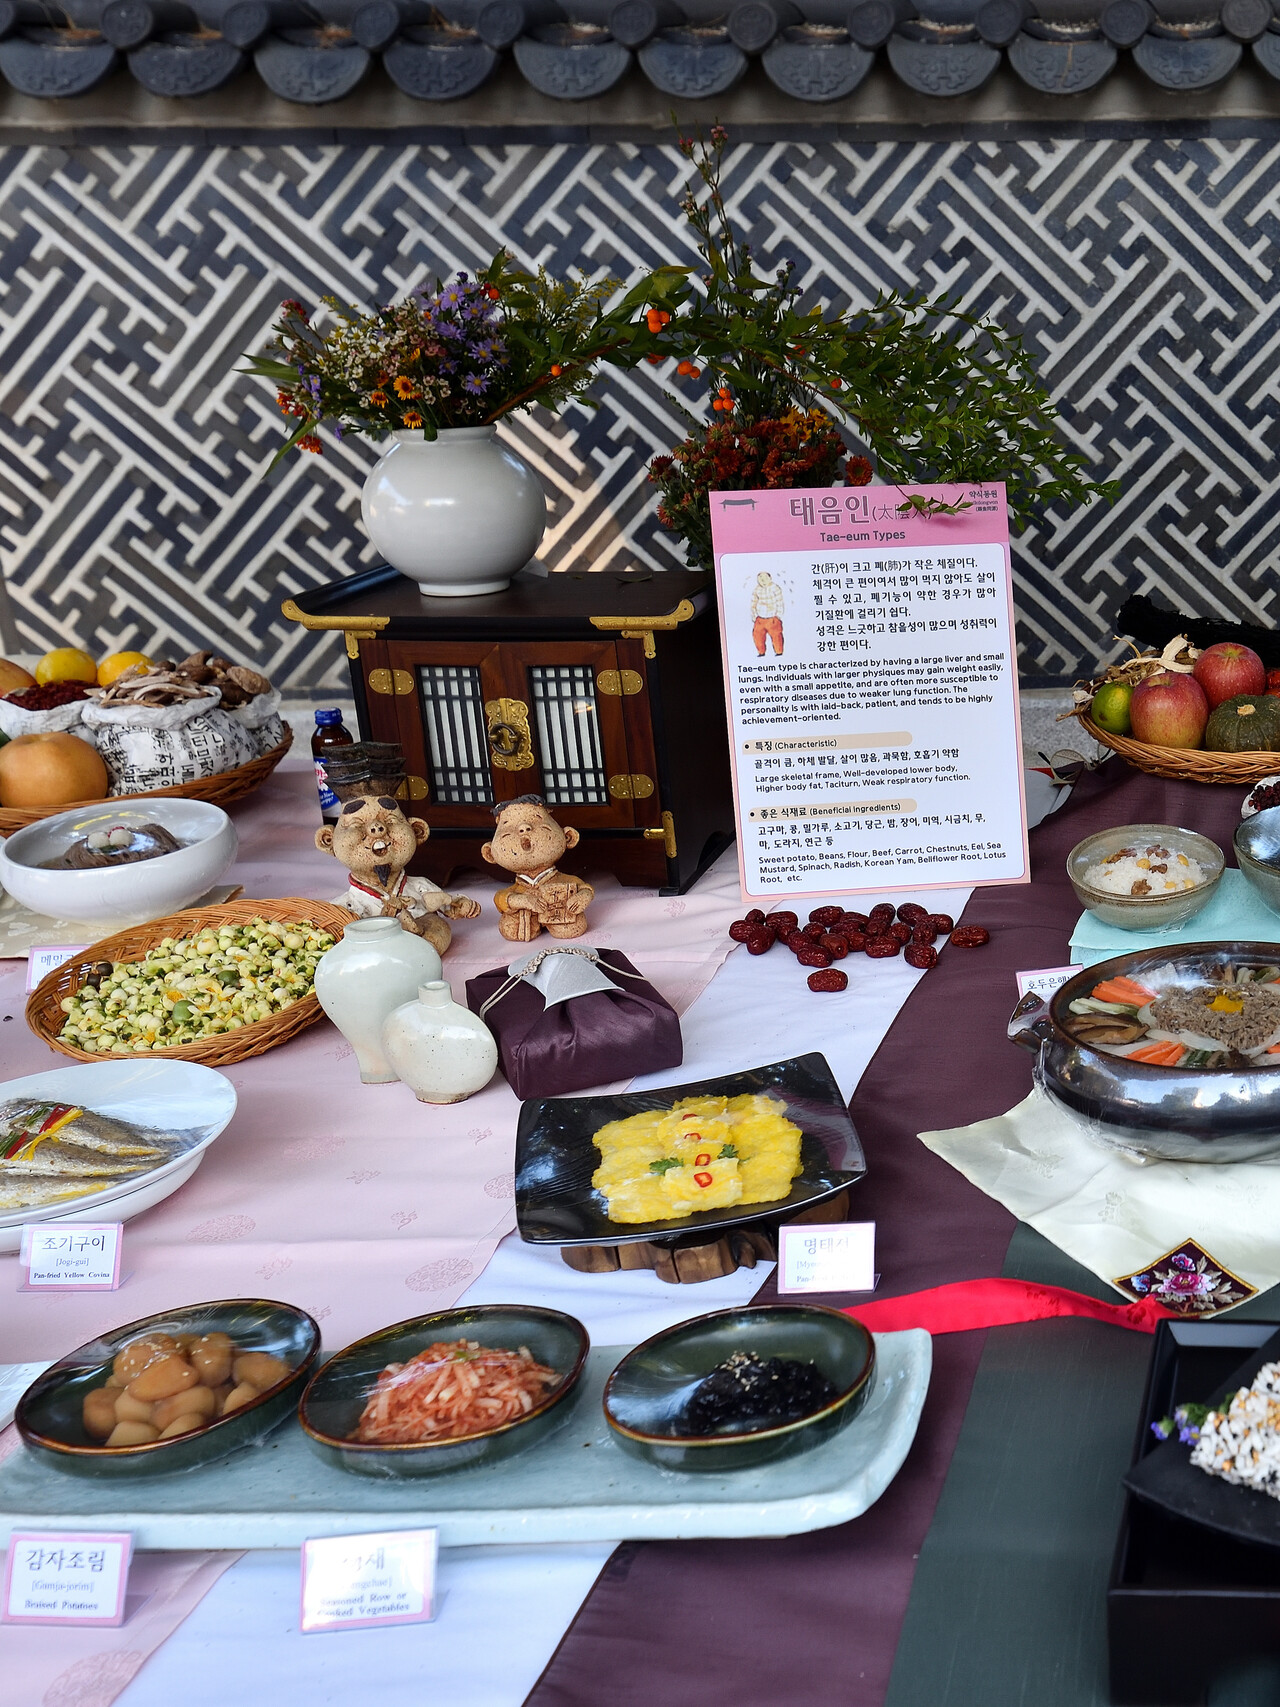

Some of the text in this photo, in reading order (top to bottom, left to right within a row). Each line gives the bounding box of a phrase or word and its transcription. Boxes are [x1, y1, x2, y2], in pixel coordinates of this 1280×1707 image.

[819, 530, 905, 542] Tae-eum Types
[852, 561, 871, 572] 크고
[914, 558, 933, 570] 작은
[936, 557, 977, 569] 체질이다.
[857, 607, 886, 619] 걸리기
[889, 606, 911, 617] 쉽다.
[817, 639, 871, 652] 강한 편이다.
[778, 663, 798, 672] type
[808, 659, 868, 669] characterized
[869, 658, 881, 667] by
[882, 657, 912, 665] having
[920, 656, 943, 664] large
[965, 653, 981, 661] and
[983, 652, 1004, 661] small
[741, 712, 841, 724] achievement-oriented.
[774, 738, 837, 750] (Characteristic)
[755, 775, 779, 783] Large
[781, 772, 813, 781] skeletal
[814, 771, 841, 779] frame,
[842, 766, 908, 777] Well-developed
[934, 764, 957, 772] body,
[755, 784, 783, 793] Higher
[785, 782, 806, 791] body
[824, 780, 860, 788] Taciturn,
[861, 778, 885, 786] Weak
[887, 776, 932, 785] respiratory
[934, 773, 970, 781] function.
[780, 807, 807, 817] 식재료
[809, 806, 851, 816] (Beneficial
[758, 825, 787, 835] 고구마,
[834, 820, 862, 830] 소고기,
[864, 819, 884, 830] 당근,
[900, 817, 920, 827] 장어,
[922, 815, 942, 825] 미역,
[944, 813, 972, 824] 시금치,
[758, 855, 785, 864] Sweet
[786, 854, 817, 863] potato,
[818, 852, 845, 860] Beans,
[847, 850, 870, 858] Flour,
[872, 848, 893, 856] Beef,
[894, 846, 924, 855] Carrot,
[925, 844, 969, 853] Chestnuts,
[986, 841, 1001, 849] Sea
[1027, 975, 1073, 990] 호두은행
[42, 1235, 105, 1252] 조기구이
[55, 1258, 89, 1267] [Jogi-gui]
[25, 1548, 106, 1573] 감자조림
